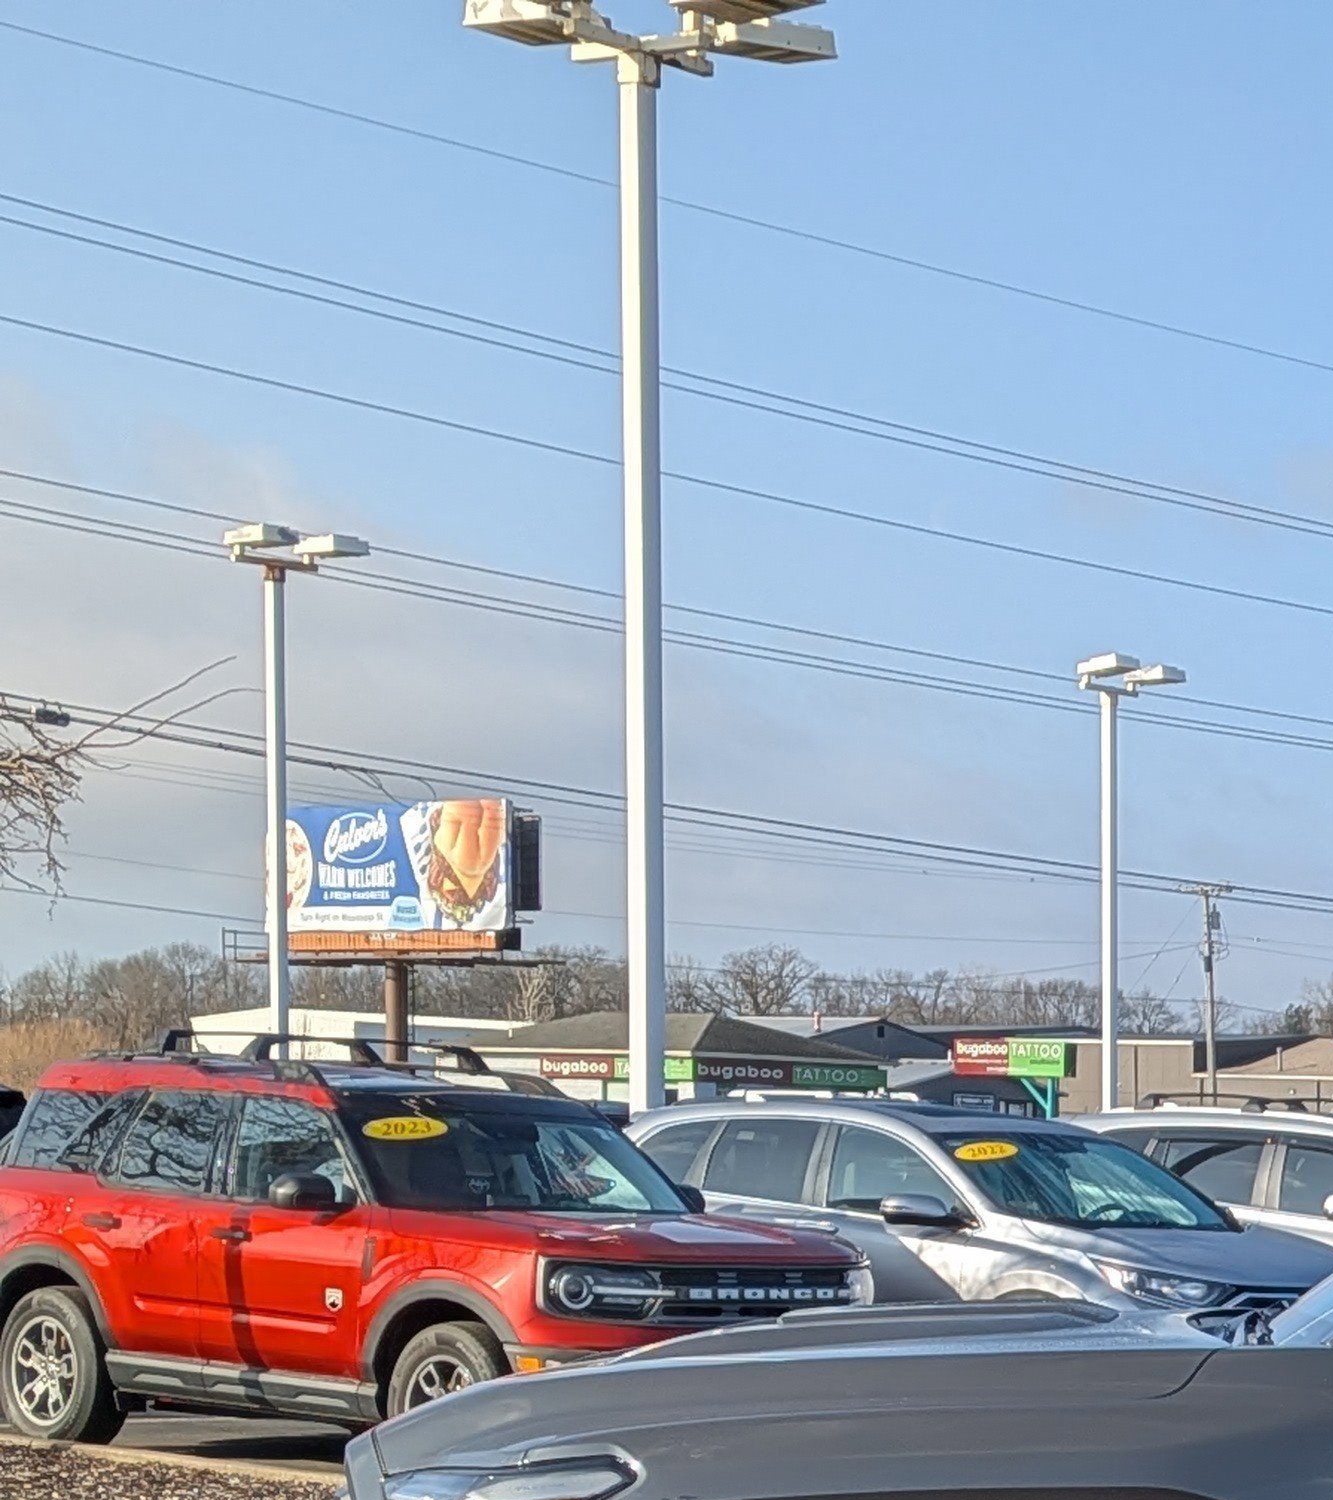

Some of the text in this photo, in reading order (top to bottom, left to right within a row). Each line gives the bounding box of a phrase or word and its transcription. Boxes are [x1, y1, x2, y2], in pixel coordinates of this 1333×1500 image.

[346, 860, 397, 888] WELCOMES
[956, 1041, 1061, 1058] bugaboo TATTOO
[542, 1058, 608, 1076] bugaboo
[697, 1063, 784, 1079] bugaboo
[794, 1067, 859, 1082] TATTOO
[382, 1121, 432, 1136] 2023
[689, 1288, 834, 1300] BRONCO
